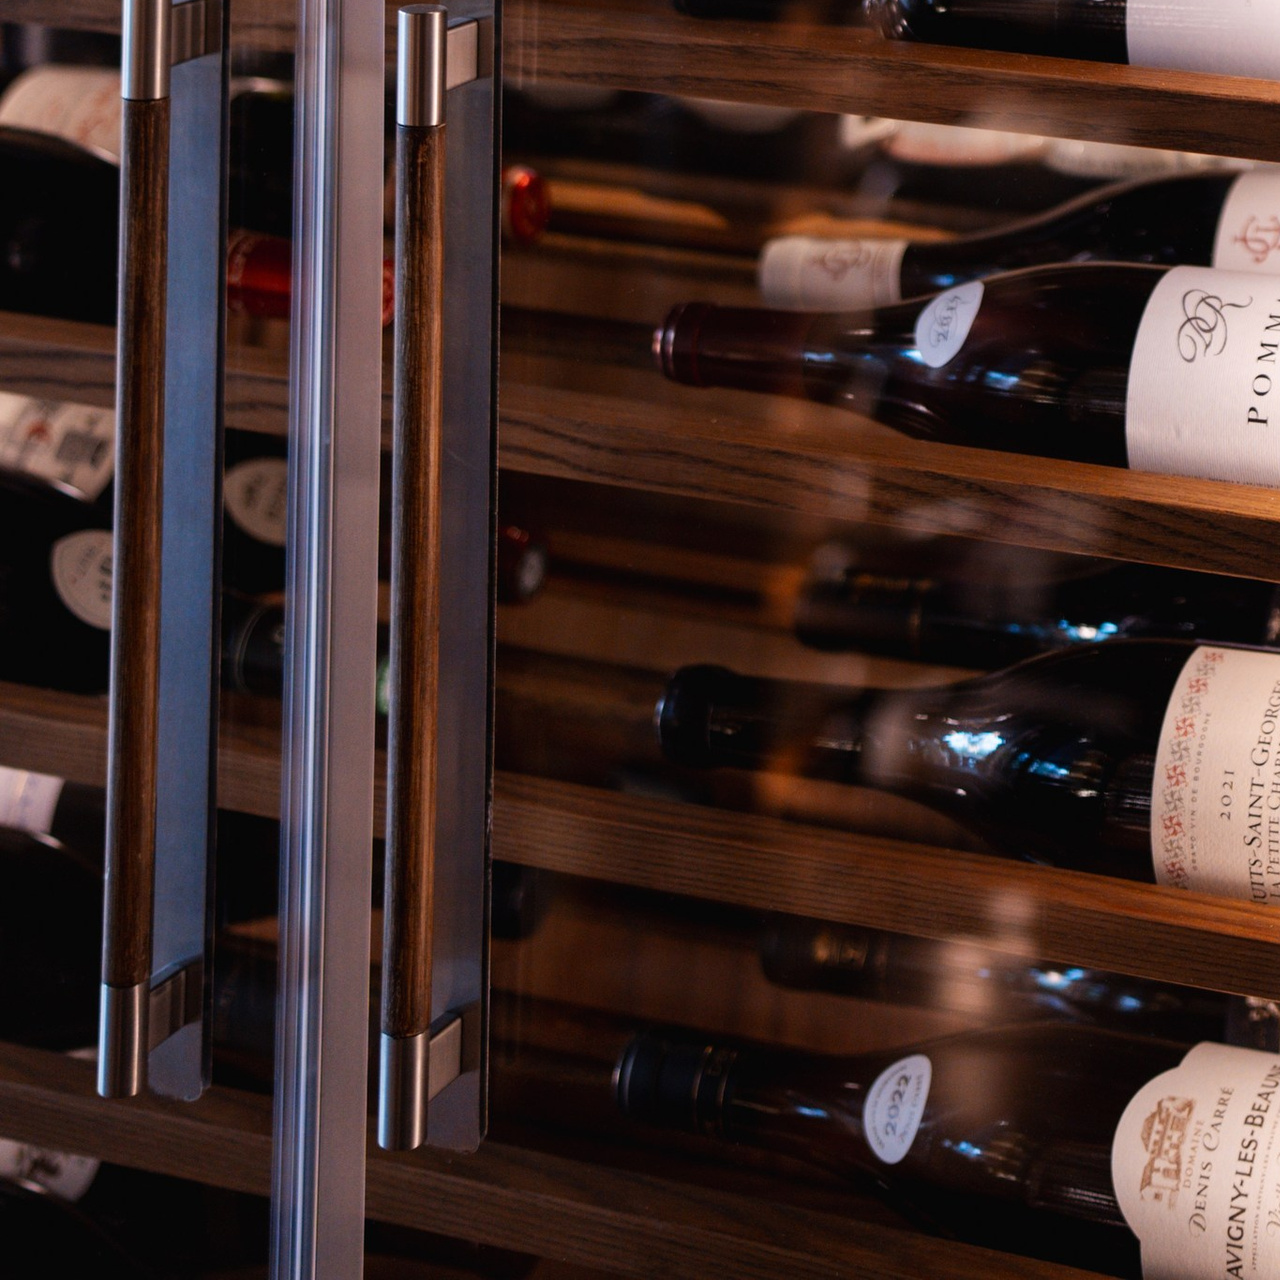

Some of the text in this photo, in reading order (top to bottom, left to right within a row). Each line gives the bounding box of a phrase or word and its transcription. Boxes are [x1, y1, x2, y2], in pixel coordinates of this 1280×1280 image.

[1189, 712, 1212, 872] GRAND VIN DE BOURGOGNE
[1219, 769, 1235, 822] 2021
[884, 1074, 911, 1136] 2022
[1182, 1120, 1204, 1189] DOMAINE
